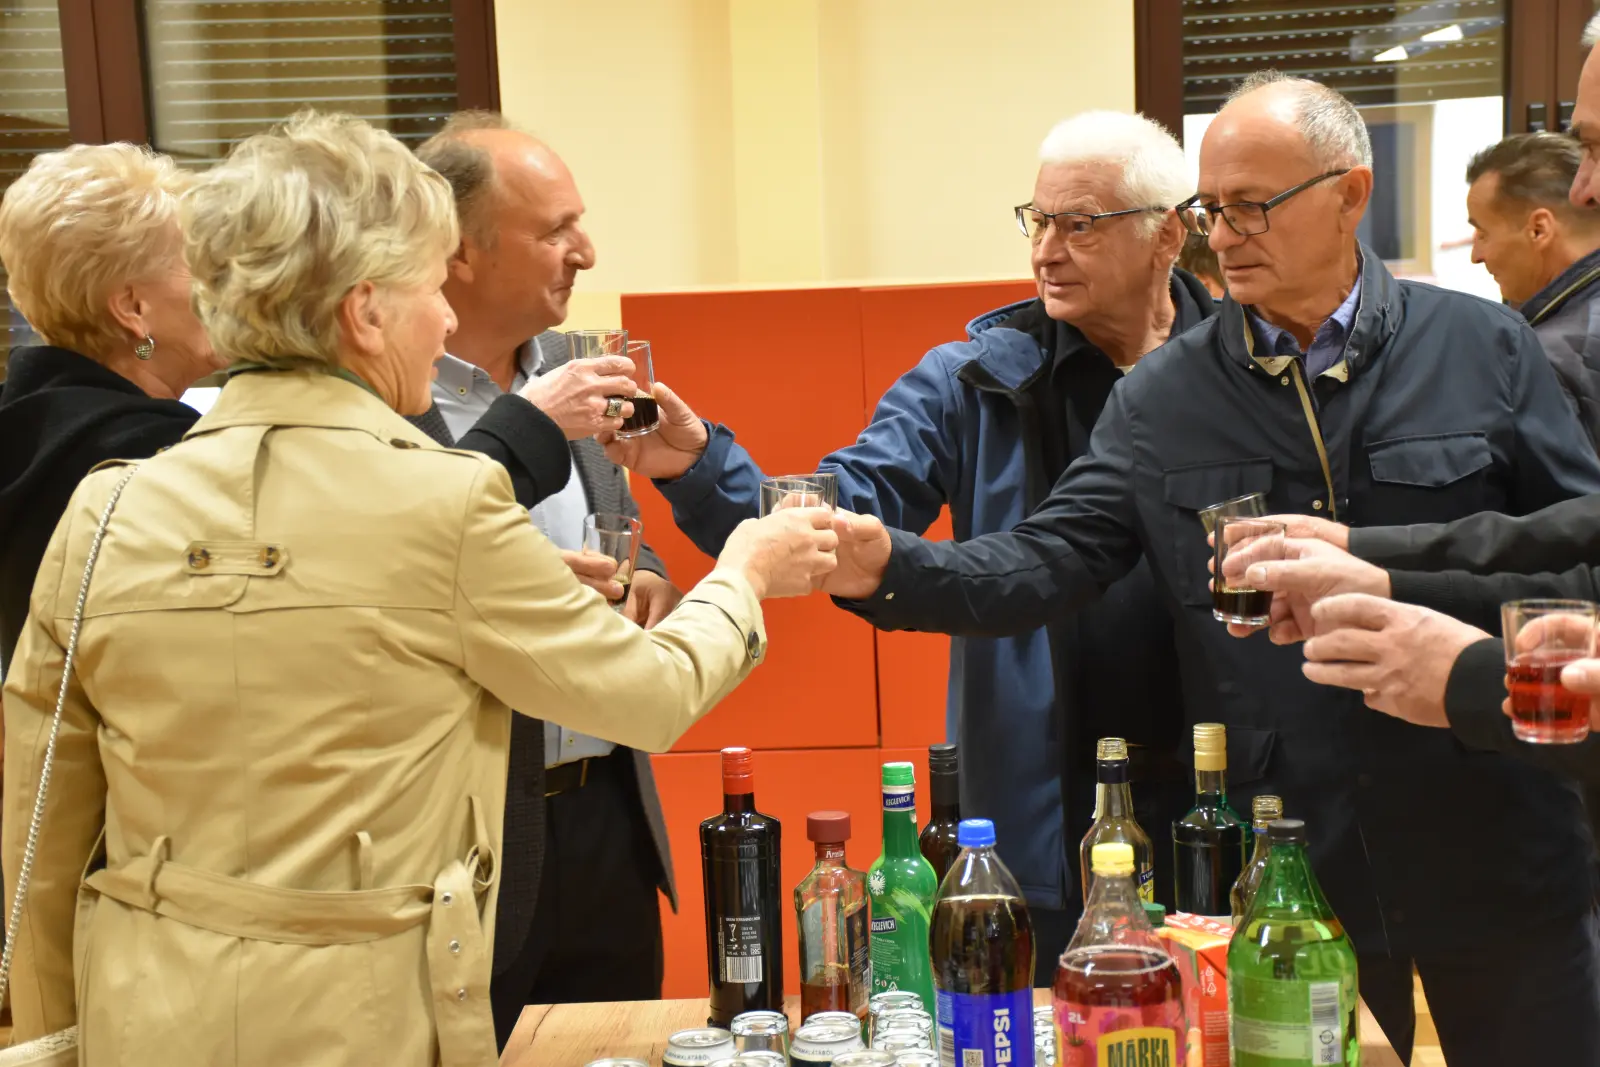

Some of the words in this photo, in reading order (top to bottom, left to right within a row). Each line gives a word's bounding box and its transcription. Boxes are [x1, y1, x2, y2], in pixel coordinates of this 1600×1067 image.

[885, 795, 911, 806] KEGLEVICH
[1068, 1012, 1087, 1024] 2L
[993, 1008, 1011, 1067] EPSI
